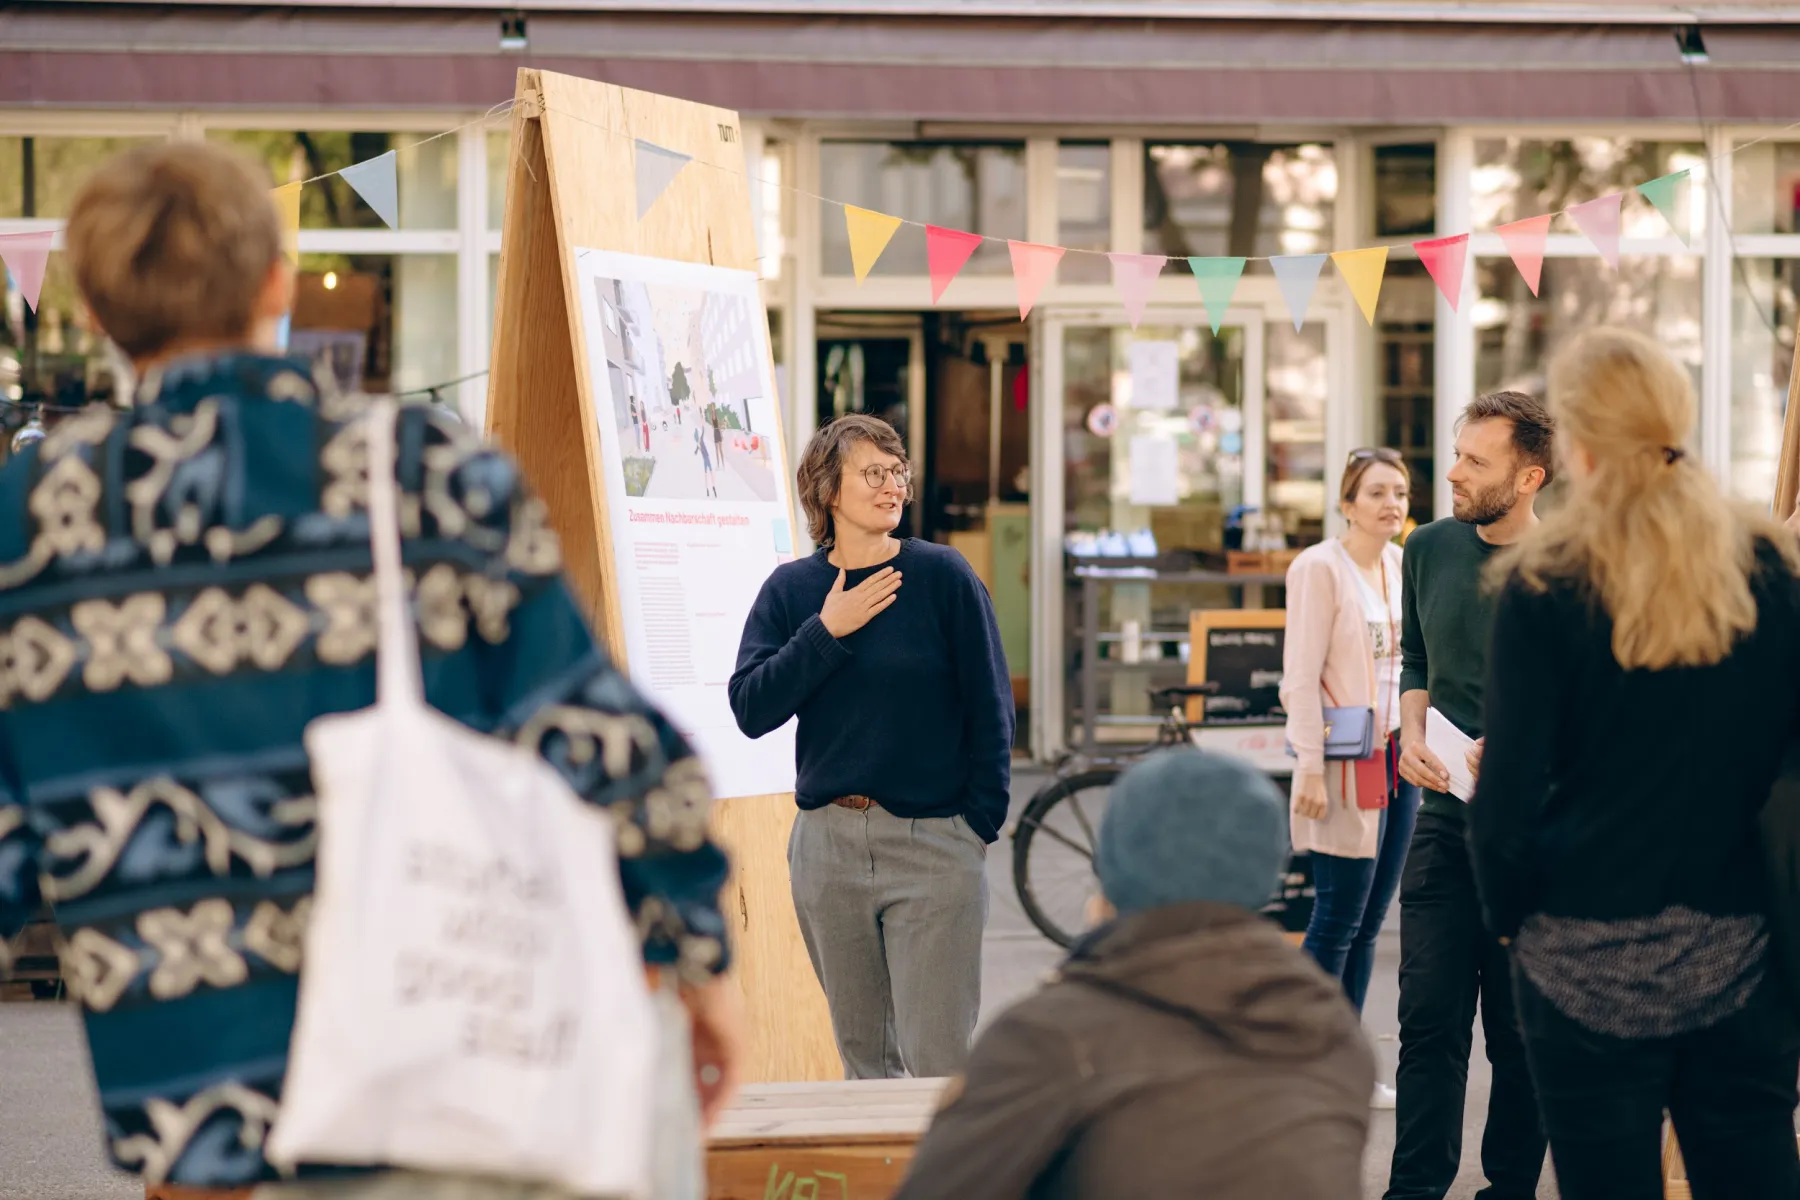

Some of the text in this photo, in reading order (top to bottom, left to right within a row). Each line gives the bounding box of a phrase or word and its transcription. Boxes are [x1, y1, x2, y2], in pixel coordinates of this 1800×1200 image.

[628, 509, 750, 528] Zusammen Nachbarschaft gestalten
